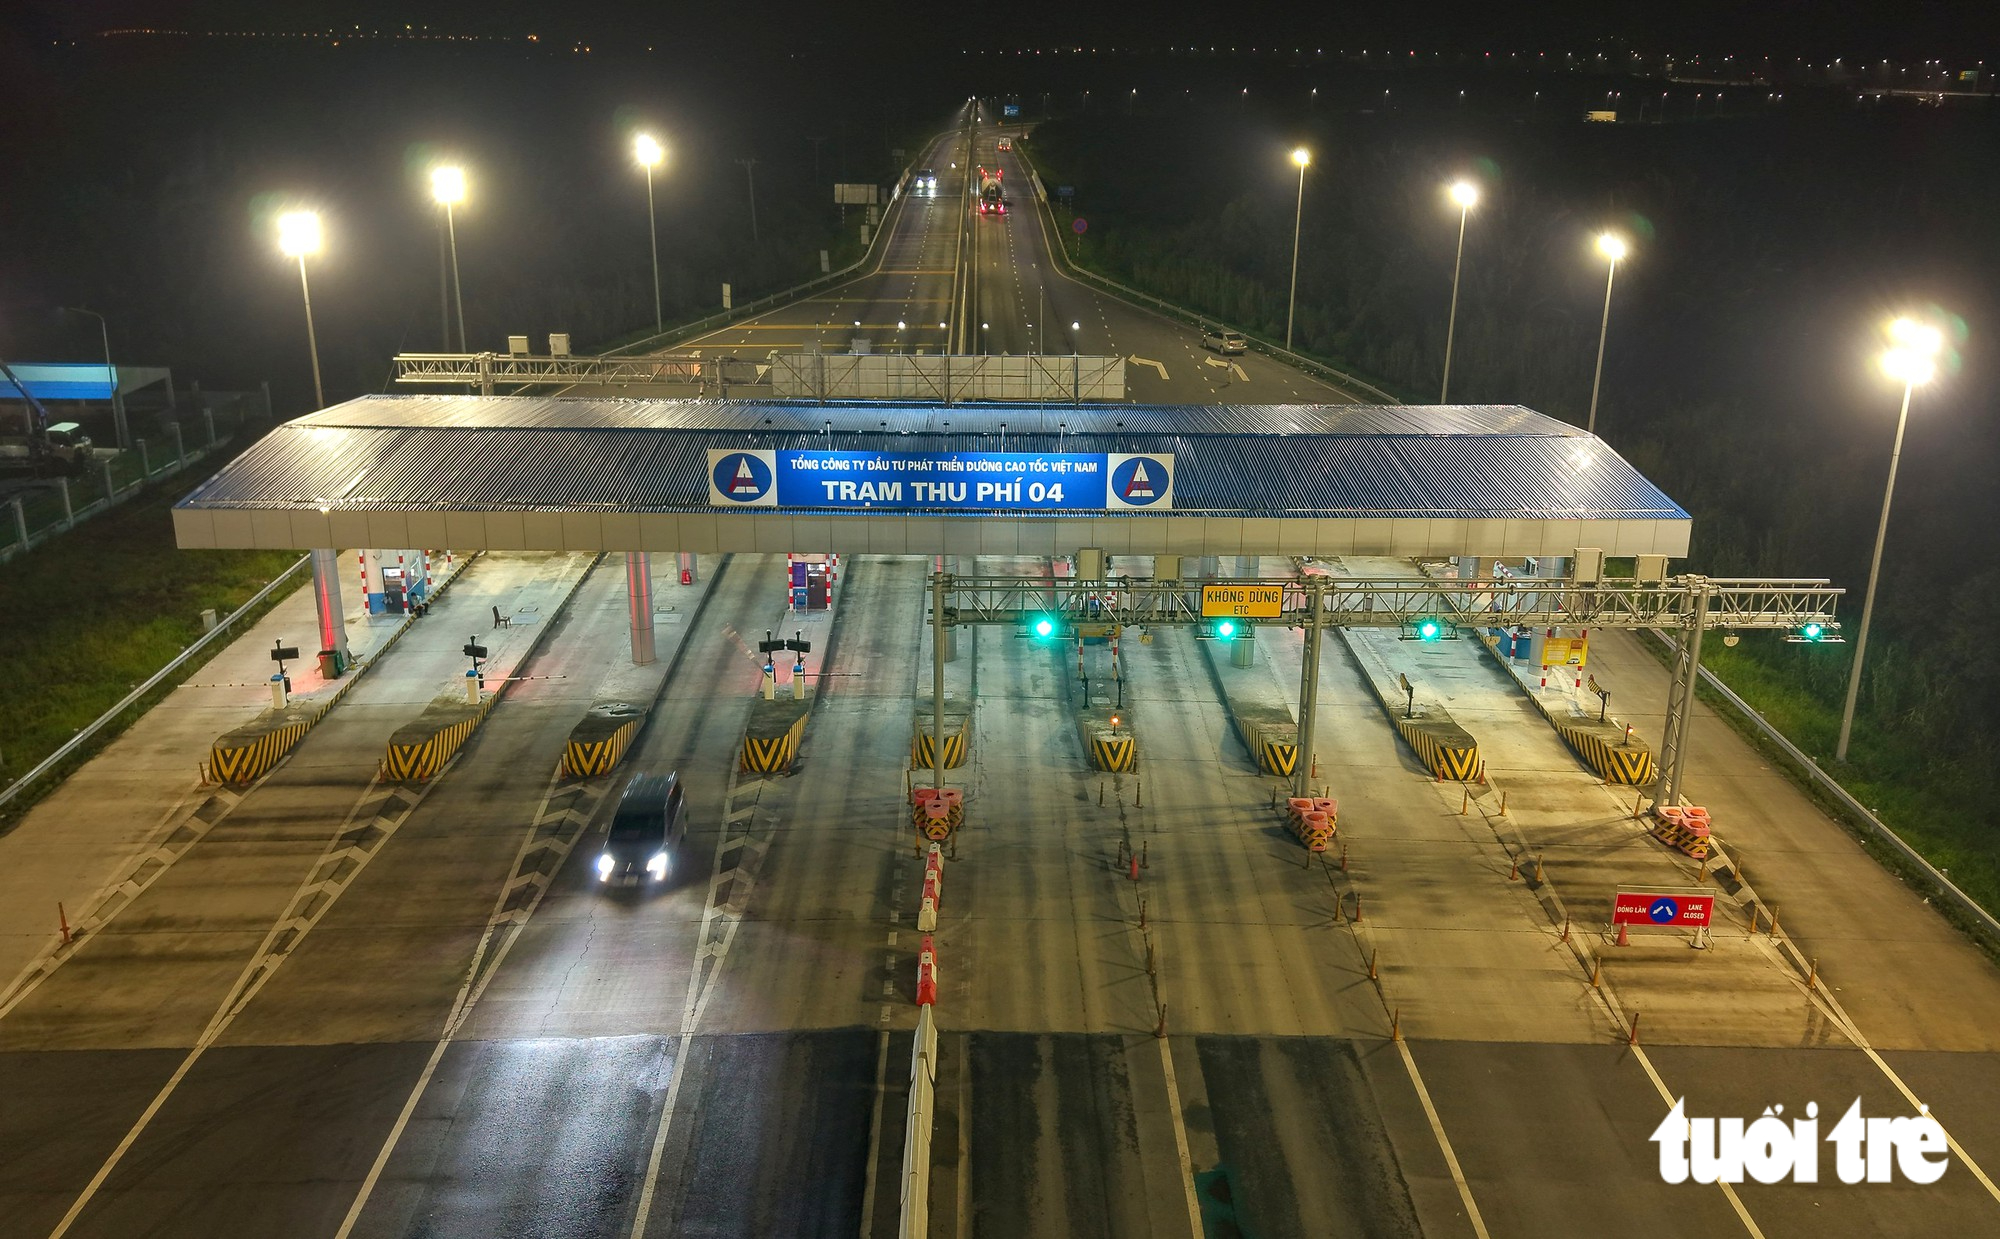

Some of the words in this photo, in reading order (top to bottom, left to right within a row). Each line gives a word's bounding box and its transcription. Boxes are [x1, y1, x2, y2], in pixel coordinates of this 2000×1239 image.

[791, 454, 819, 470] TỔNG
[821, 457, 850, 471] CÔNG
[852, 460, 866, 471] TY
[867, 456, 889, 471] ĐẦU
[892, 460, 906, 471] TƯ
[908, 459, 934, 471] PHÁT
[936, 455, 964, 472] TRIỂN
[966, 459, 1003, 472] ĐƯỜNG
[1005, 461, 1027, 472] CAO
[1029, 458, 1049, 473] TỐC
[1051, 459, 1073, 475] VIỆT
[1074, 462, 1098, 473] NAM
[821, 481, 902, 507] TRẠM
[910, 482, 967, 502] THU
[976, 477, 1024, 502] PHÍ
[1028, 482, 1065, 502] 04
[1207, 588, 1244, 603] KHÔNG
[1249, 588, 1279, 603] DỪNG
[1234, 605, 1249, 615] ETC
[1683, 912, 1705, 920] CLOSED
